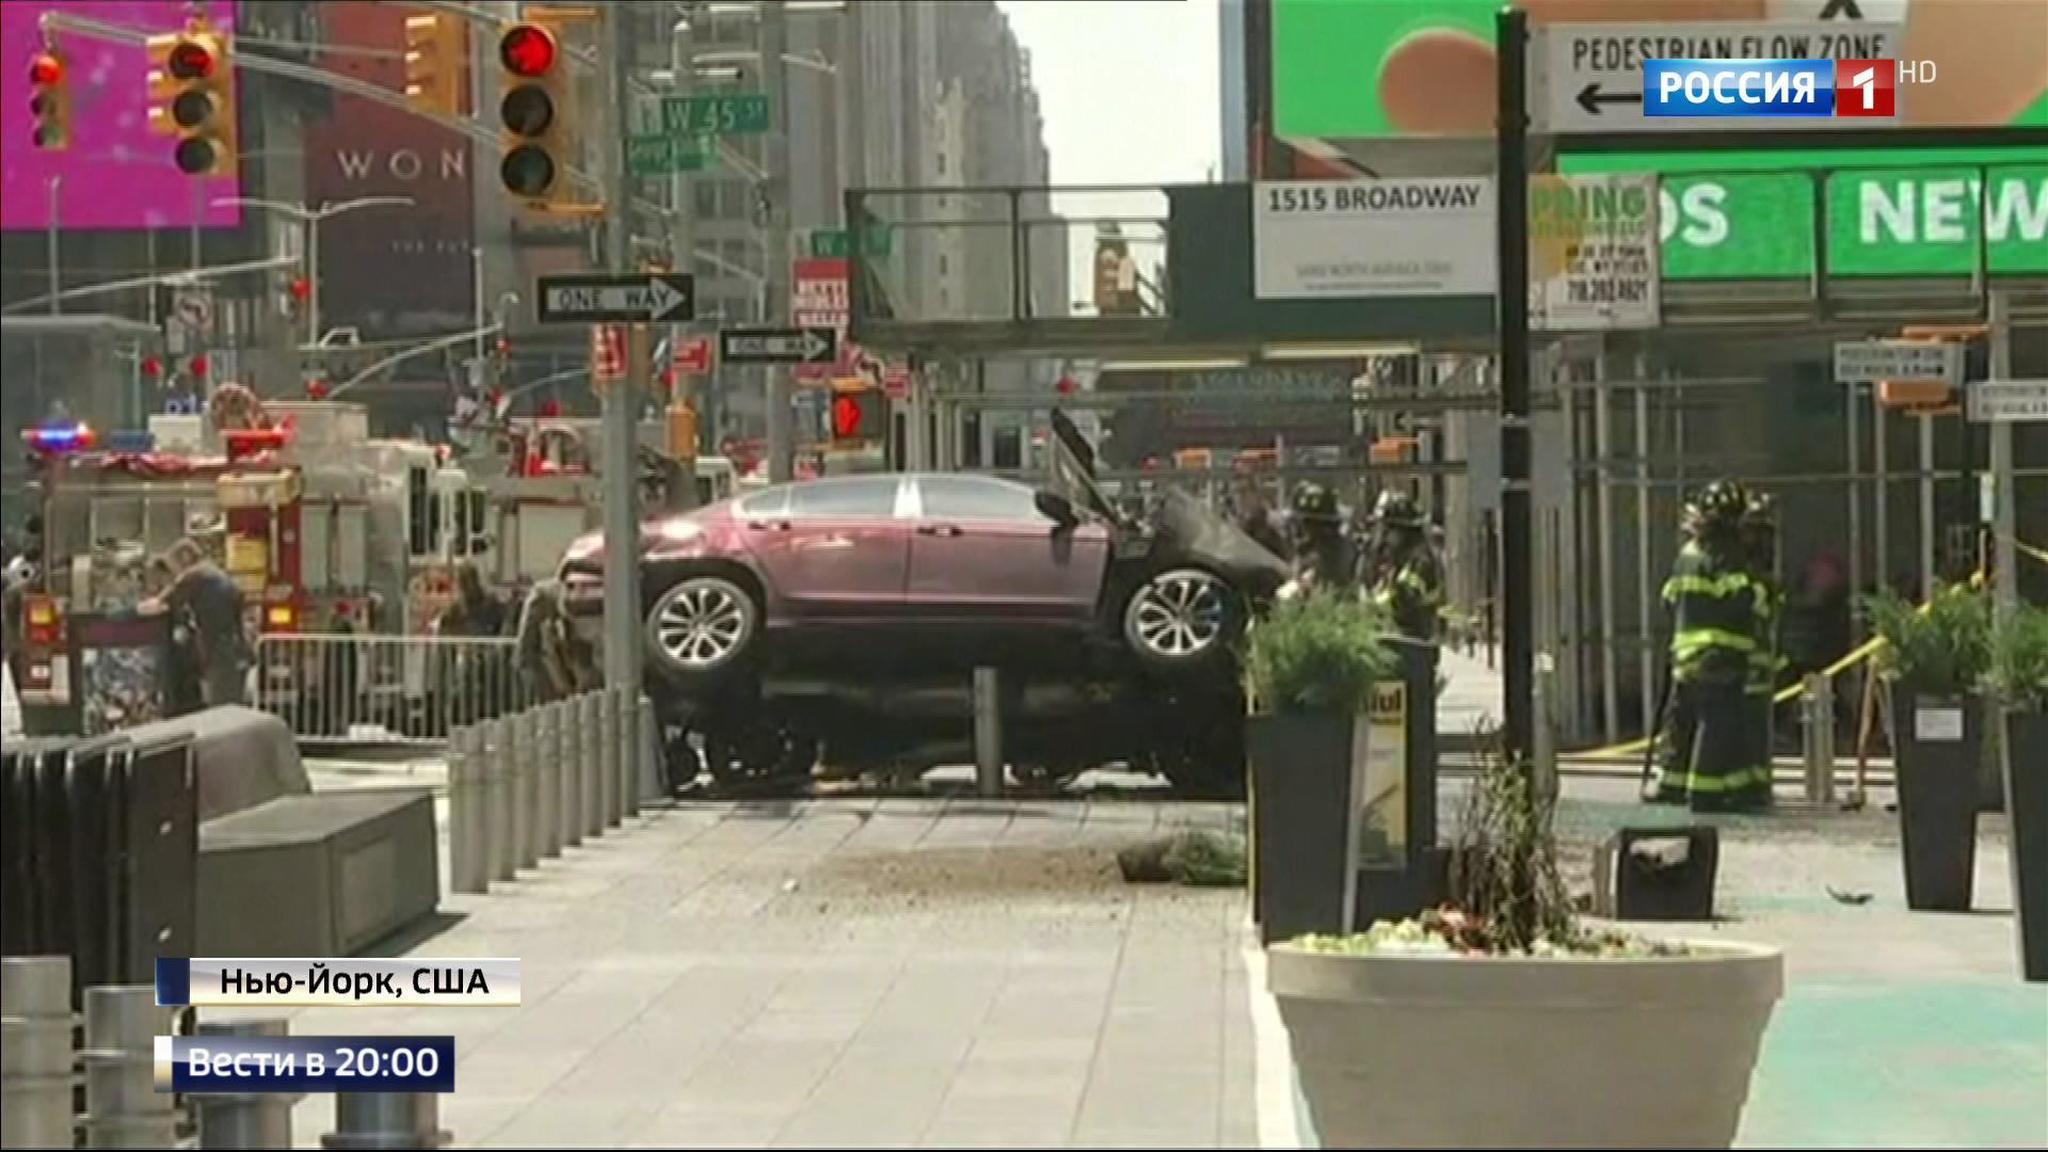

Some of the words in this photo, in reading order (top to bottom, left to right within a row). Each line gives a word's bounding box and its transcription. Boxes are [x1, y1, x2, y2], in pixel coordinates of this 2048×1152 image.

[1573, 36, 1731, 70] PEDESTRIAN
[1741, 36, 1811, 60] FLOW
[1819, 34, 1886, 60] ZONE
[667, 101, 692, 129] W
[703, 101, 736, 131] 45
[1269, 187, 1327, 212] 1515
[1335, 184, 1481, 210] BROADWAY
[559, 287, 599, 312] ONE
[624, 286, 671, 309] WAY
